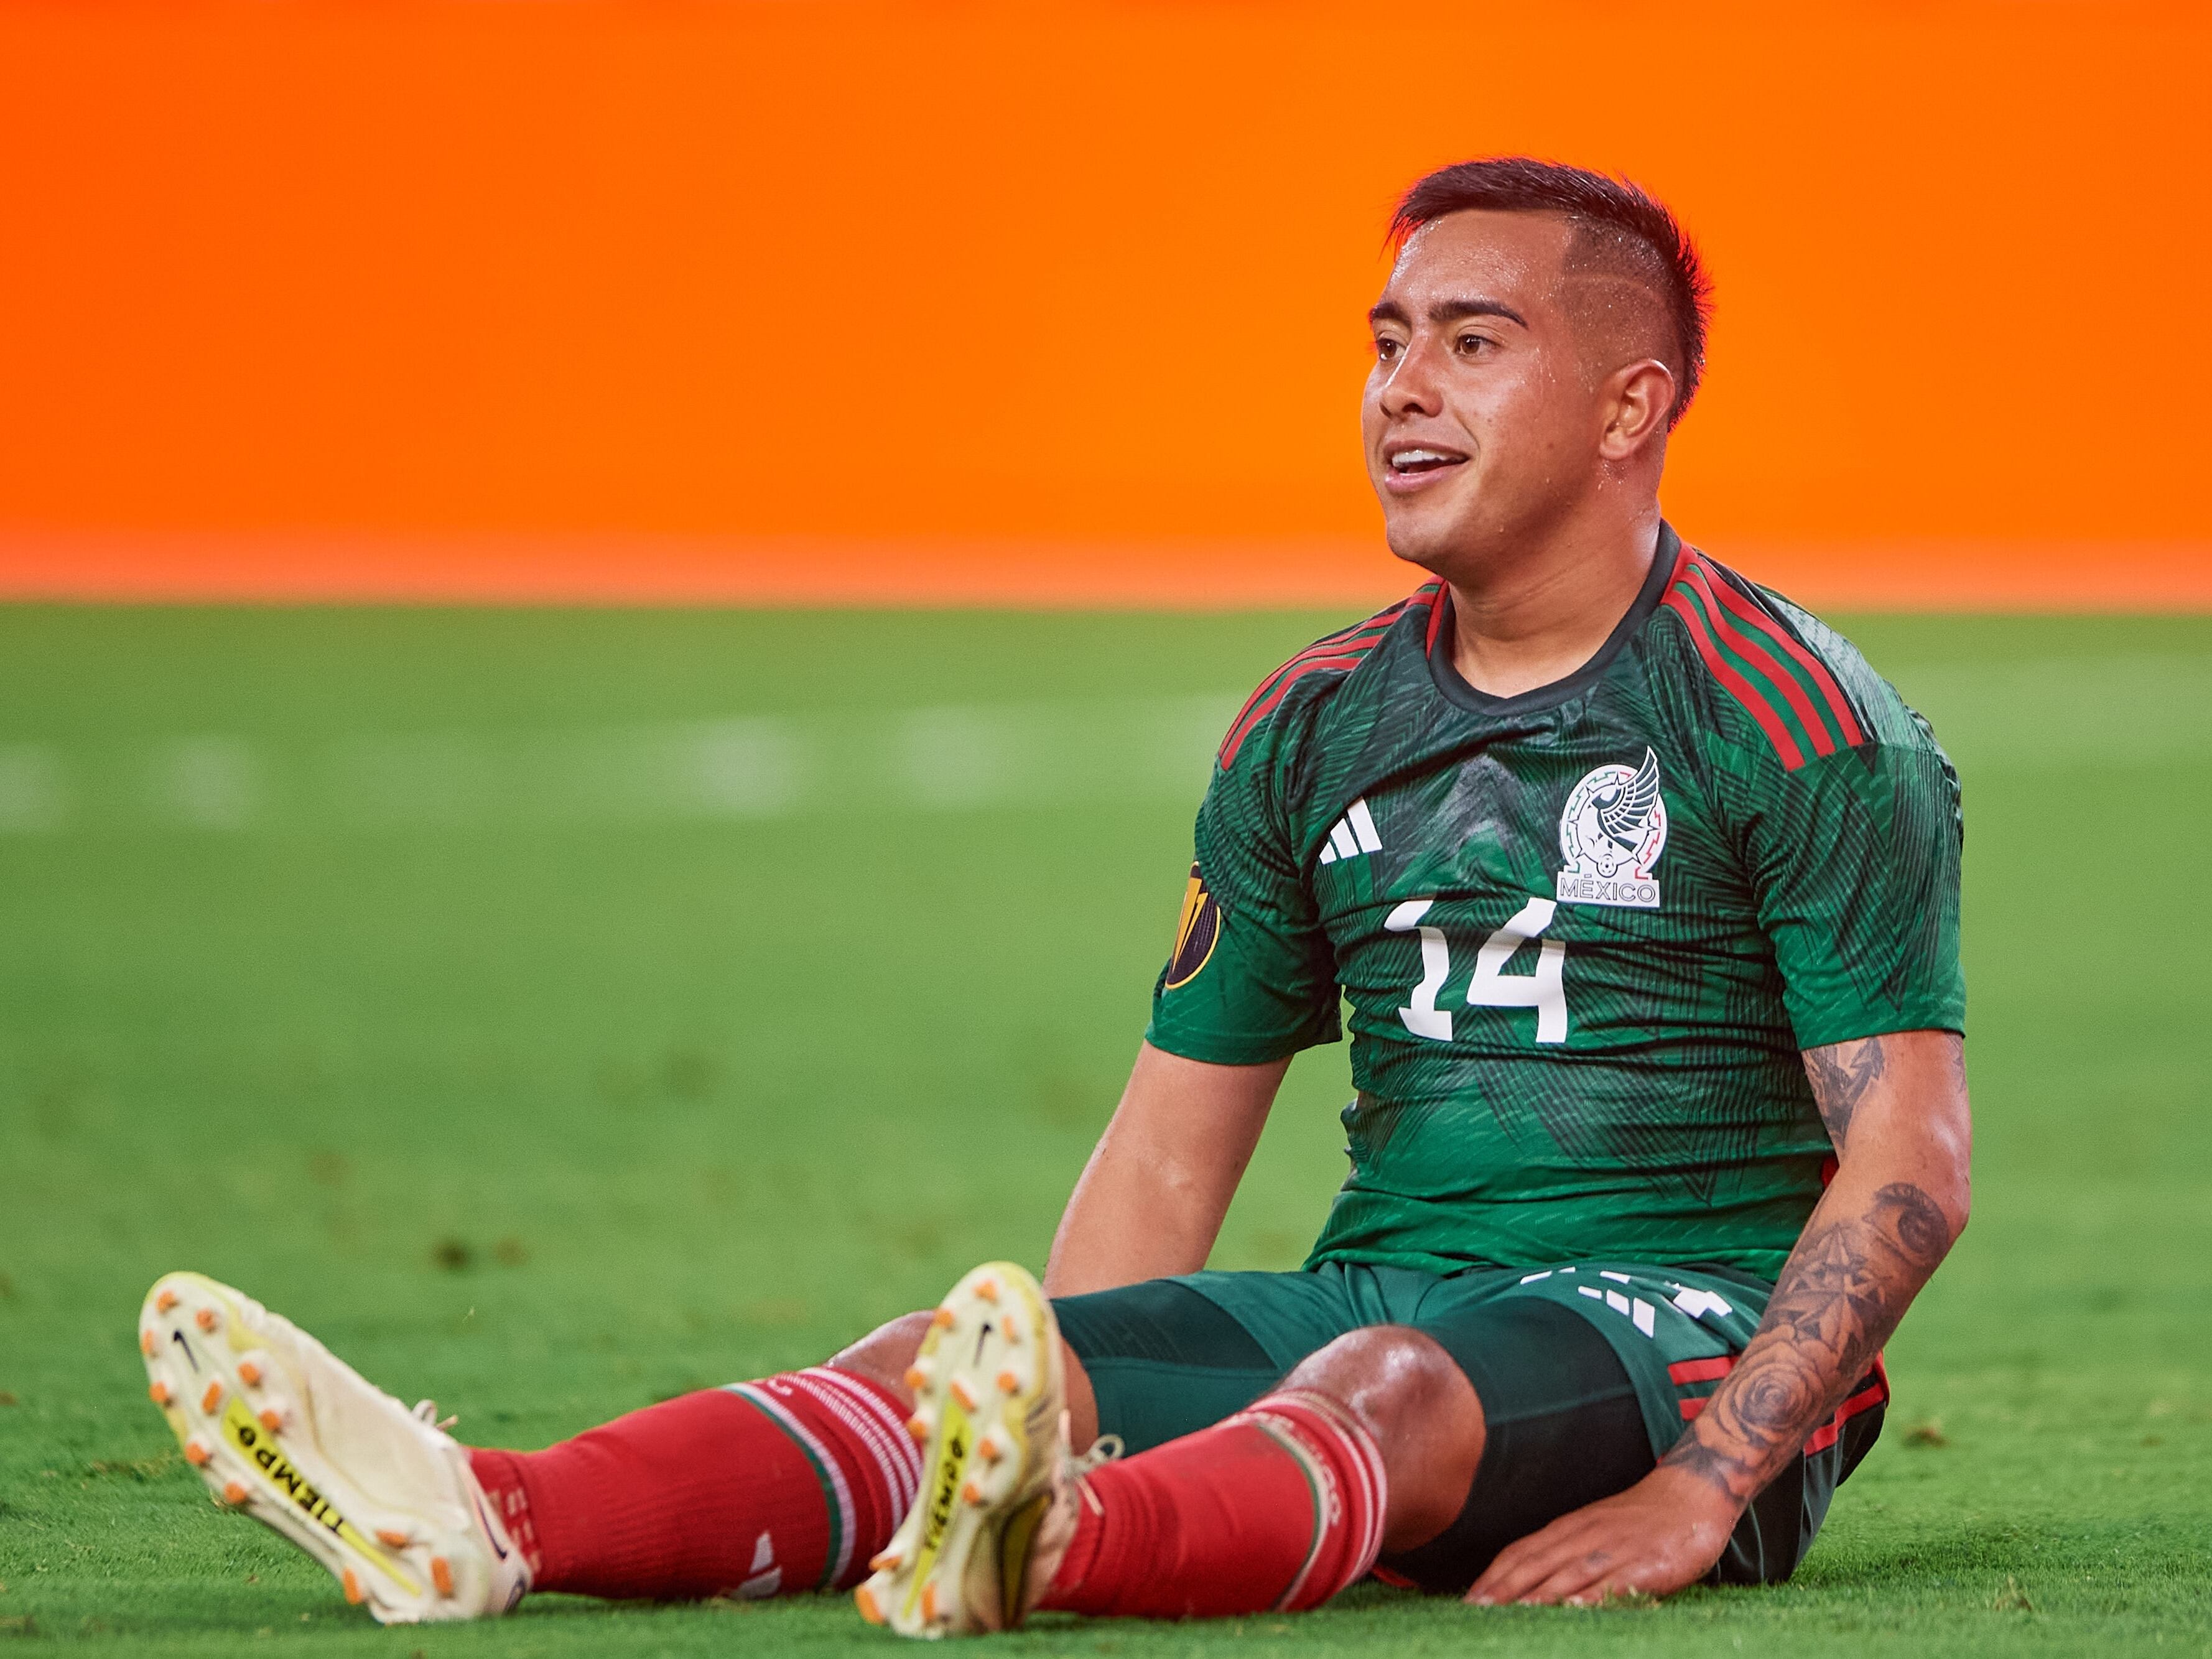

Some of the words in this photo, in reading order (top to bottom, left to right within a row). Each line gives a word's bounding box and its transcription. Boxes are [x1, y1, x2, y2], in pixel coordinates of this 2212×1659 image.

[1560, 873, 1655, 902] MÉXICO
[1384, 897, 1567, 1043] 14
[238, 1425, 344, 1535] TIEMPO
